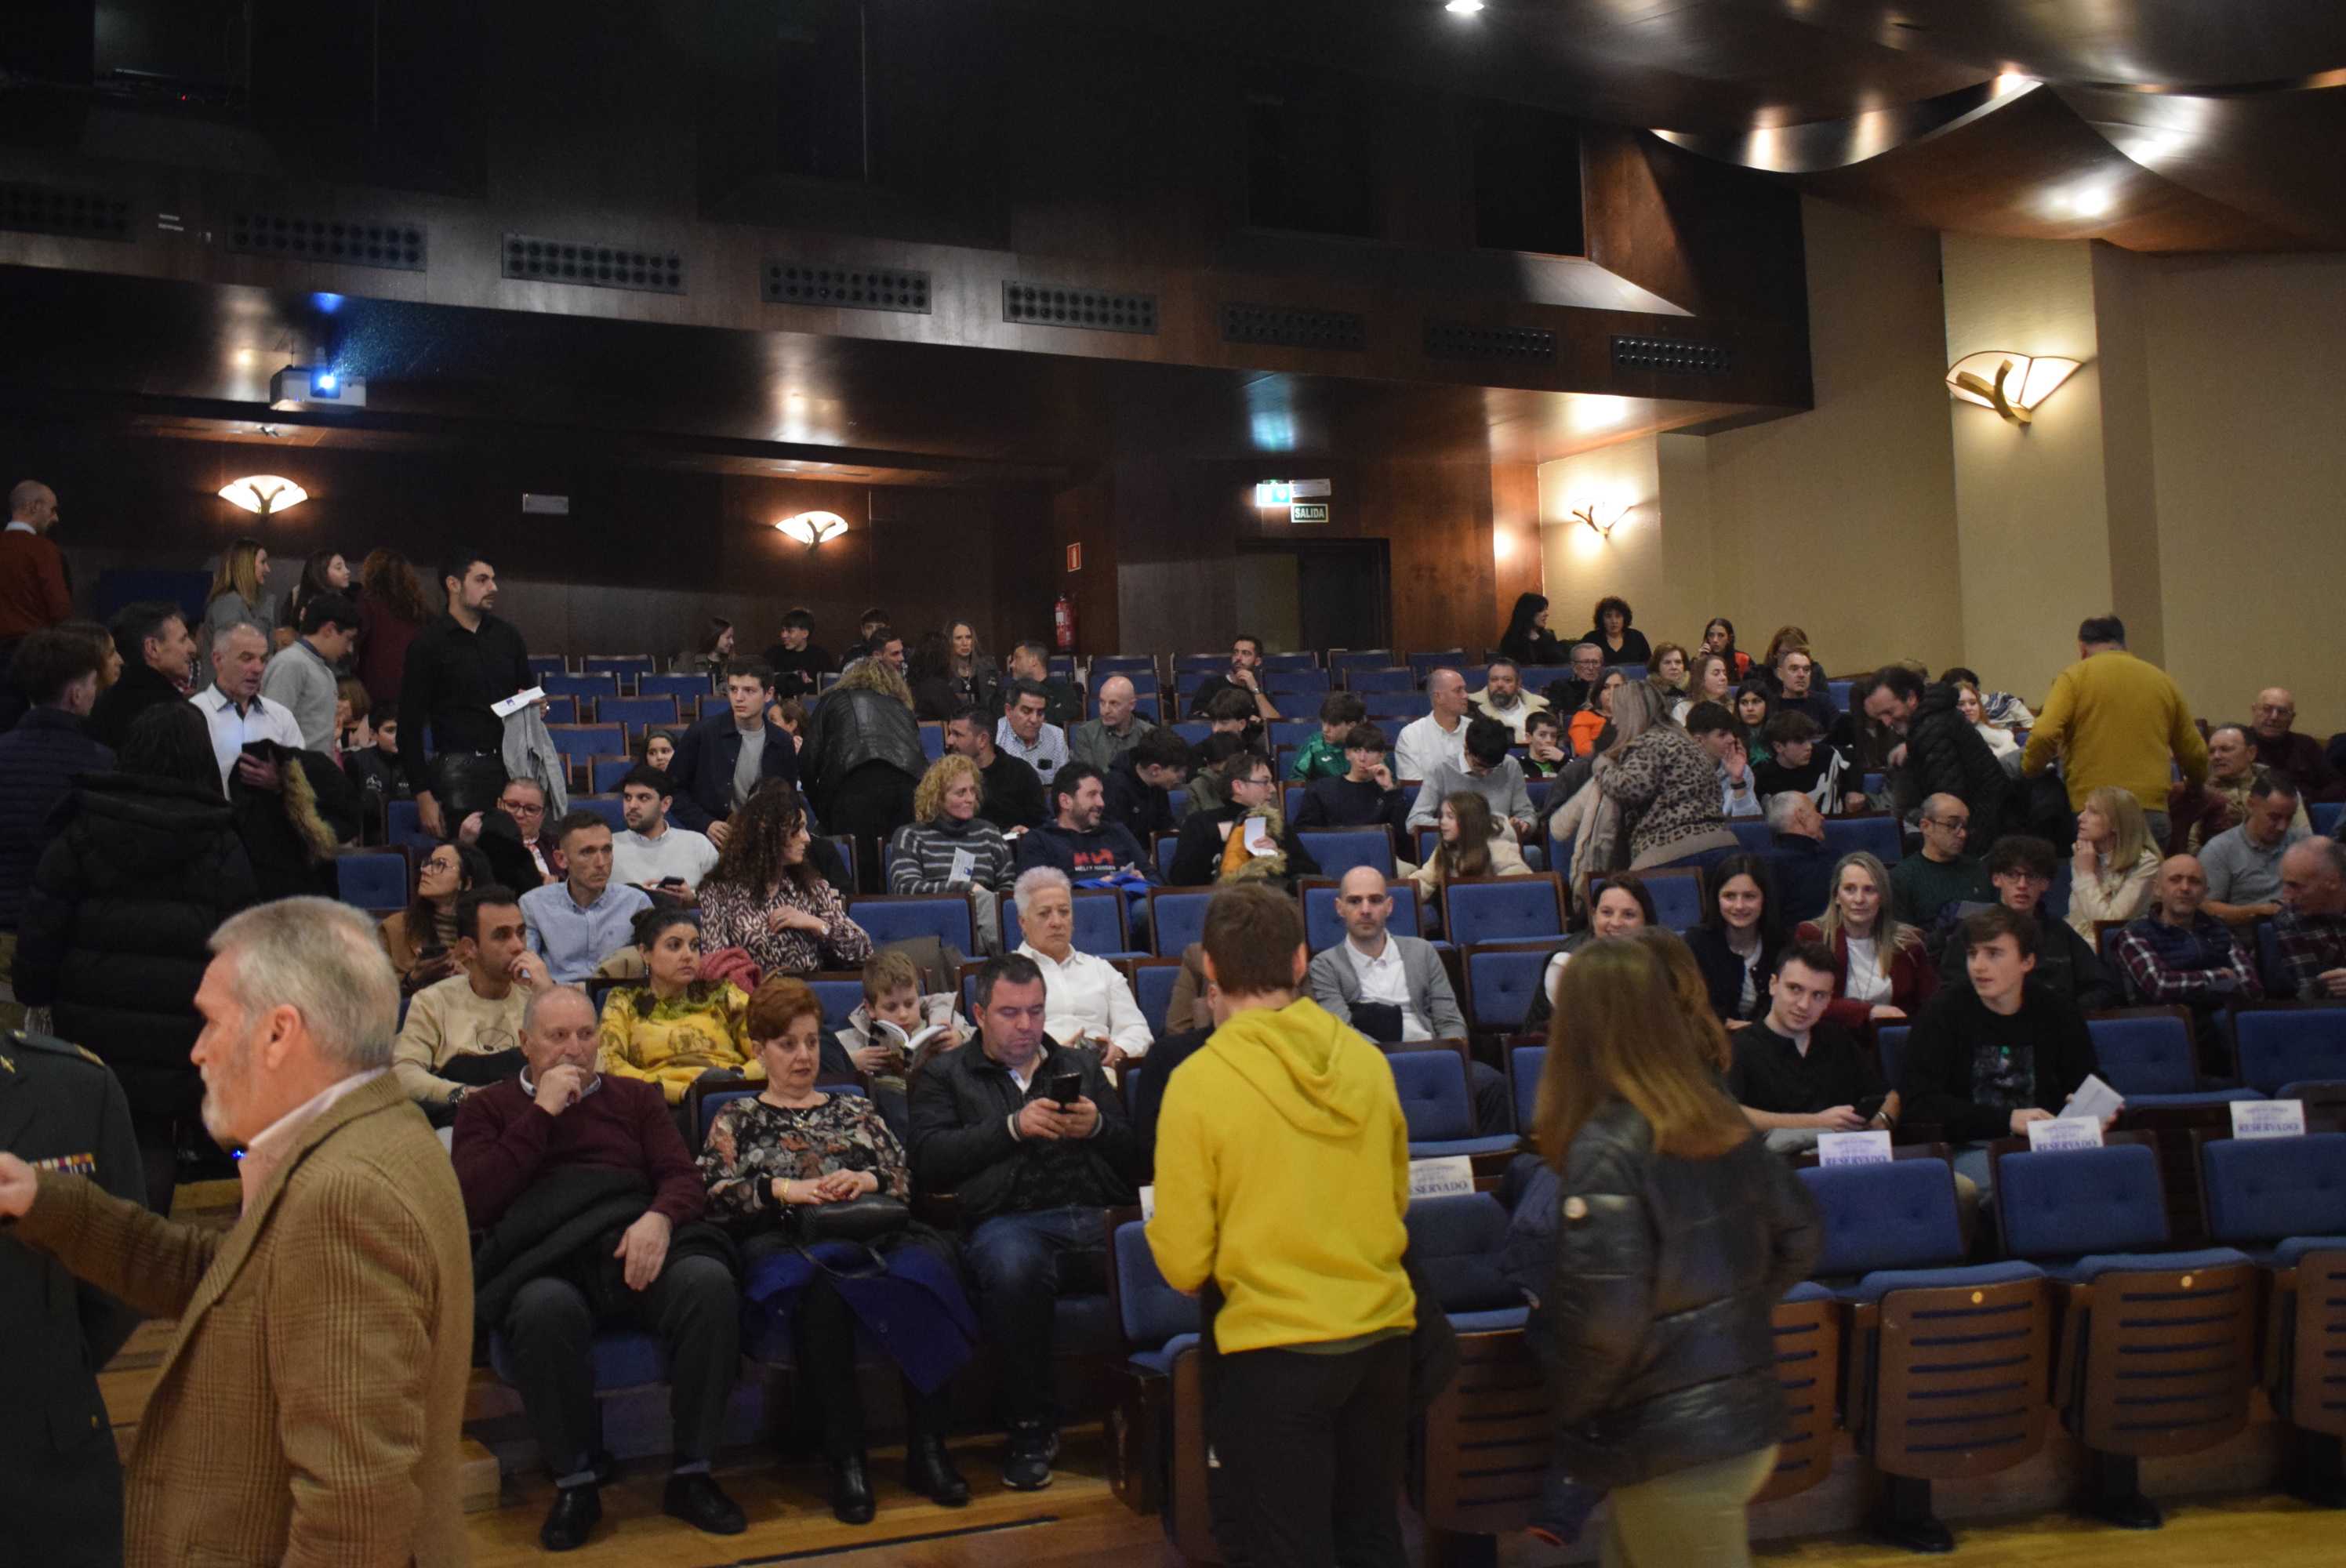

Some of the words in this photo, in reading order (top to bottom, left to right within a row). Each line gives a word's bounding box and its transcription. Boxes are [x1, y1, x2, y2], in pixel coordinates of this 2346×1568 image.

[1295, 507, 1324, 518] SALIDA
[2238, 1121, 2300, 1132] RESERVADO
[1409, 1179, 1469, 1194] SERVADO
